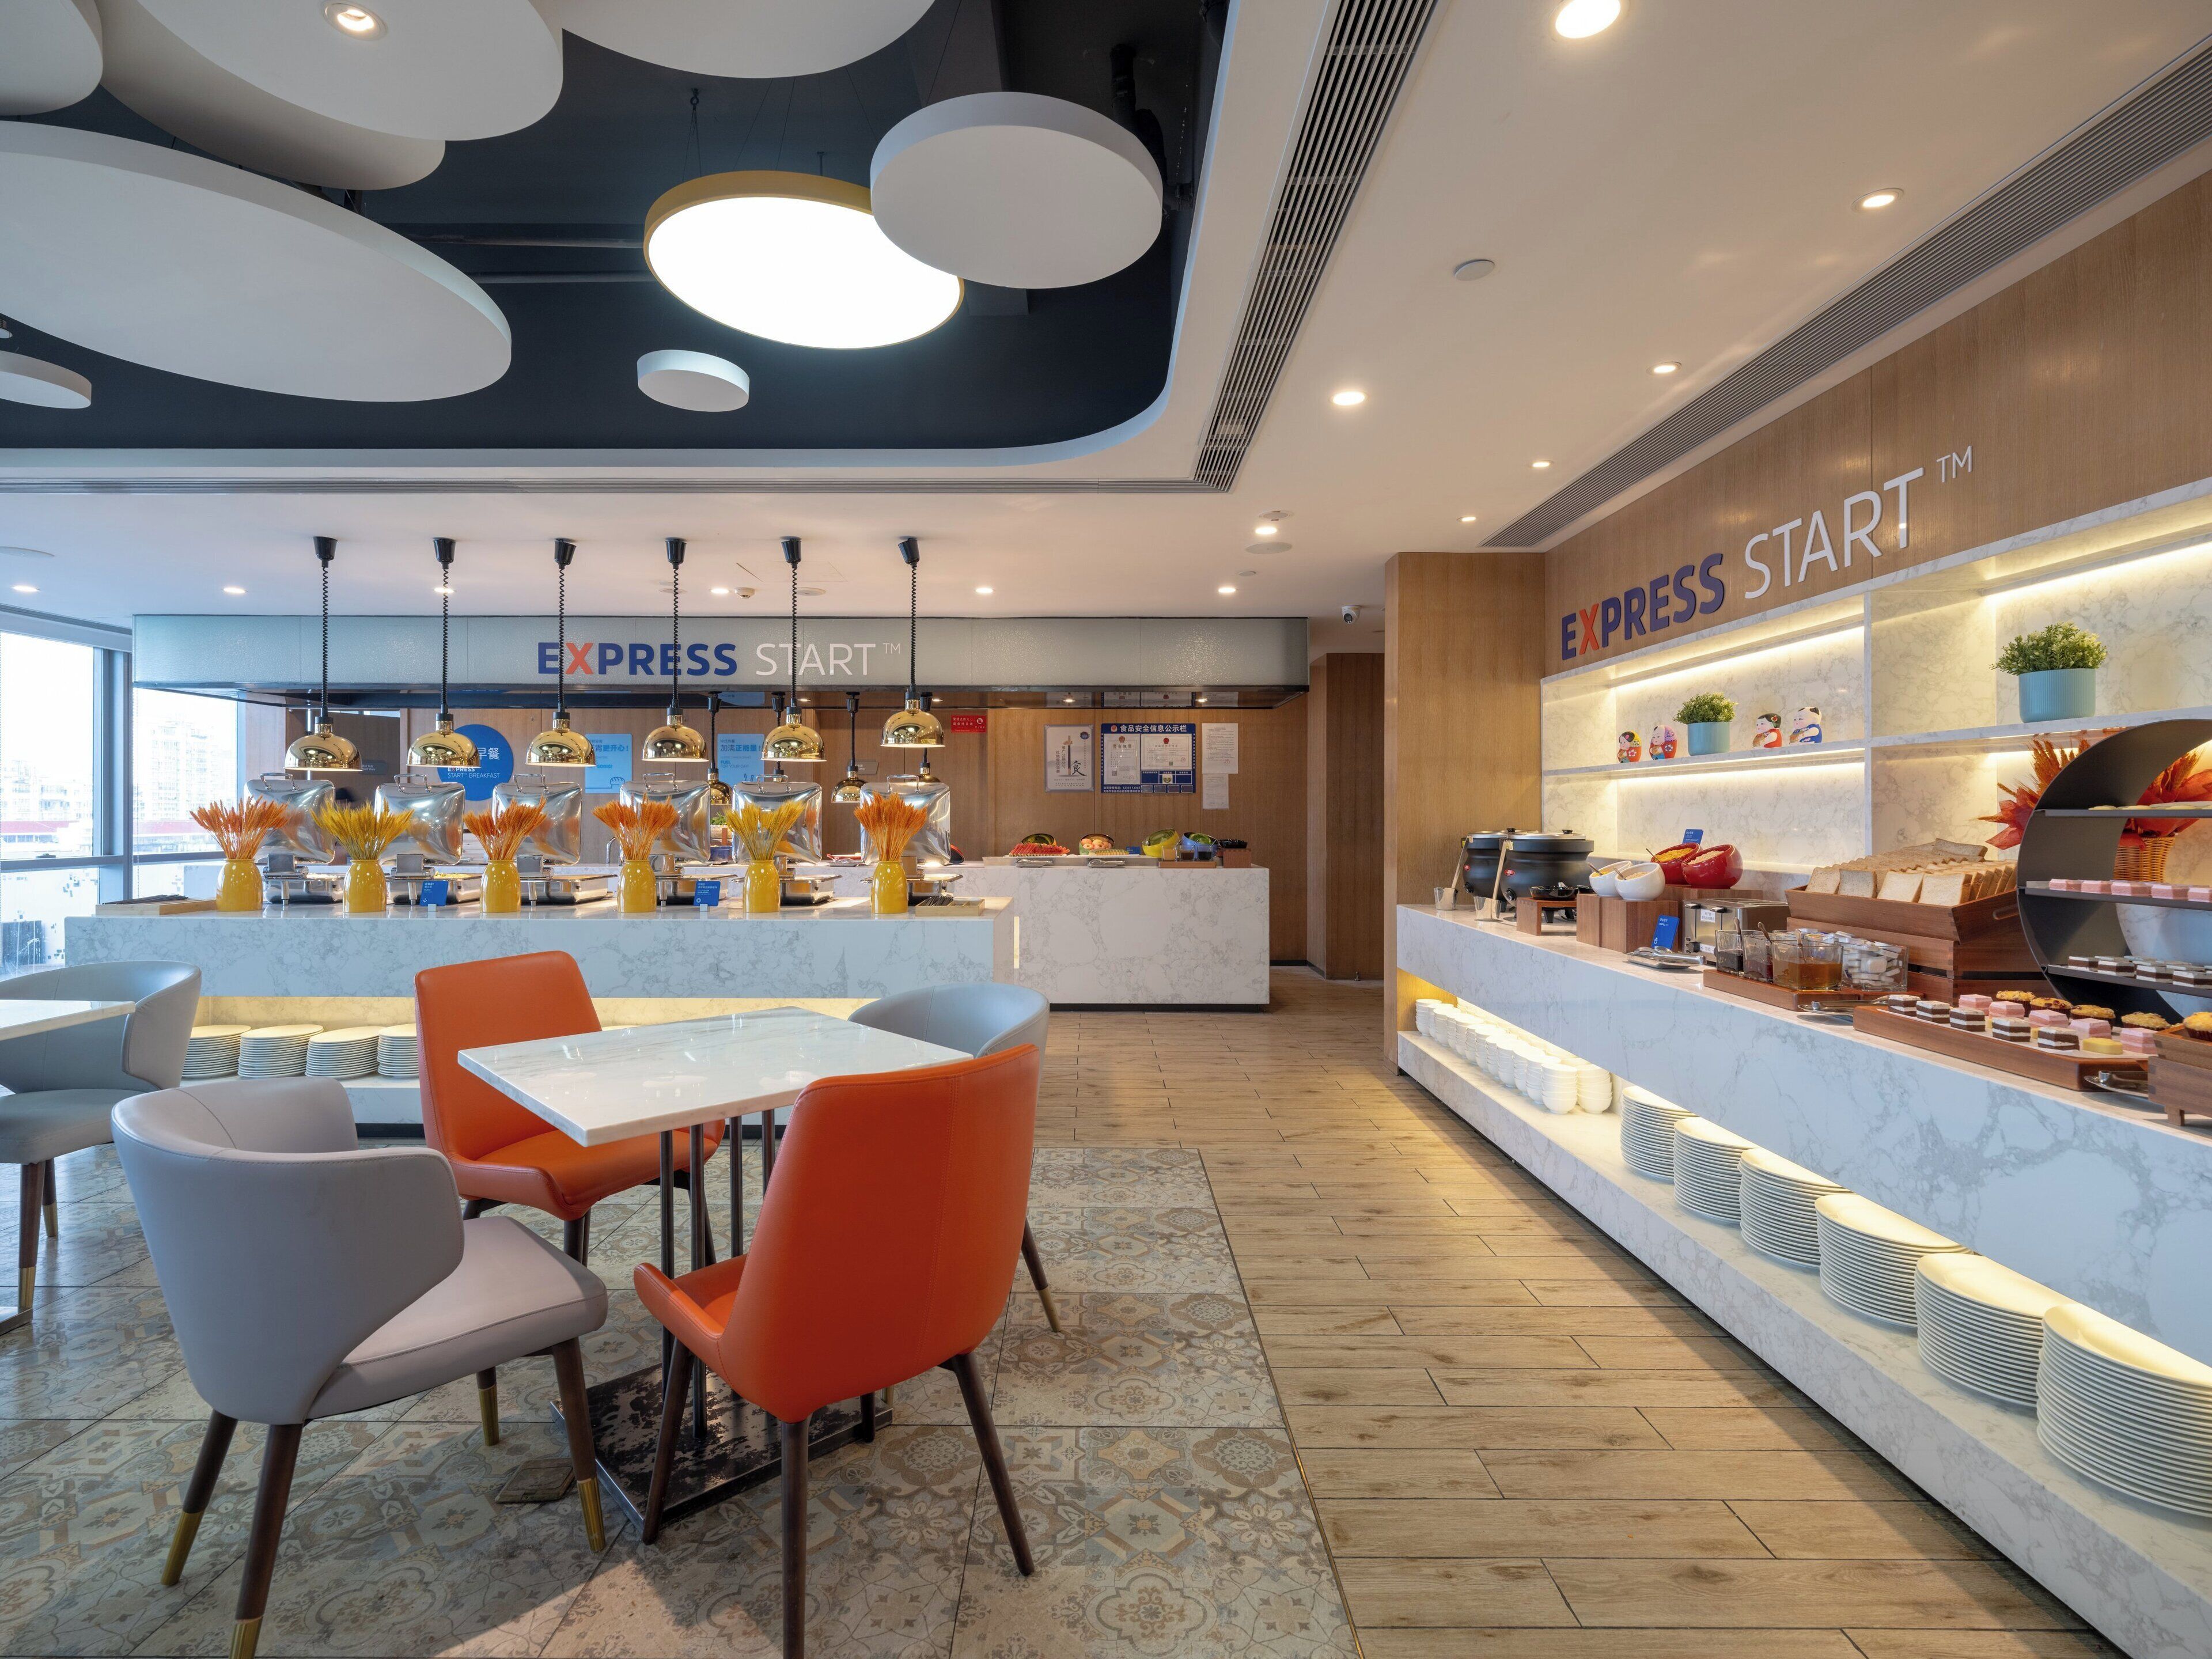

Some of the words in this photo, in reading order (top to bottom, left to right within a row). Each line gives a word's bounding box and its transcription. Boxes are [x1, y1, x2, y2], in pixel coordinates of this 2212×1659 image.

[1561, 552, 1725, 661] EXPRESS
[1744, 467, 1924, 599] START
[538, 642, 737, 676] EXPRESS
[756, 642, 876, 676] START
